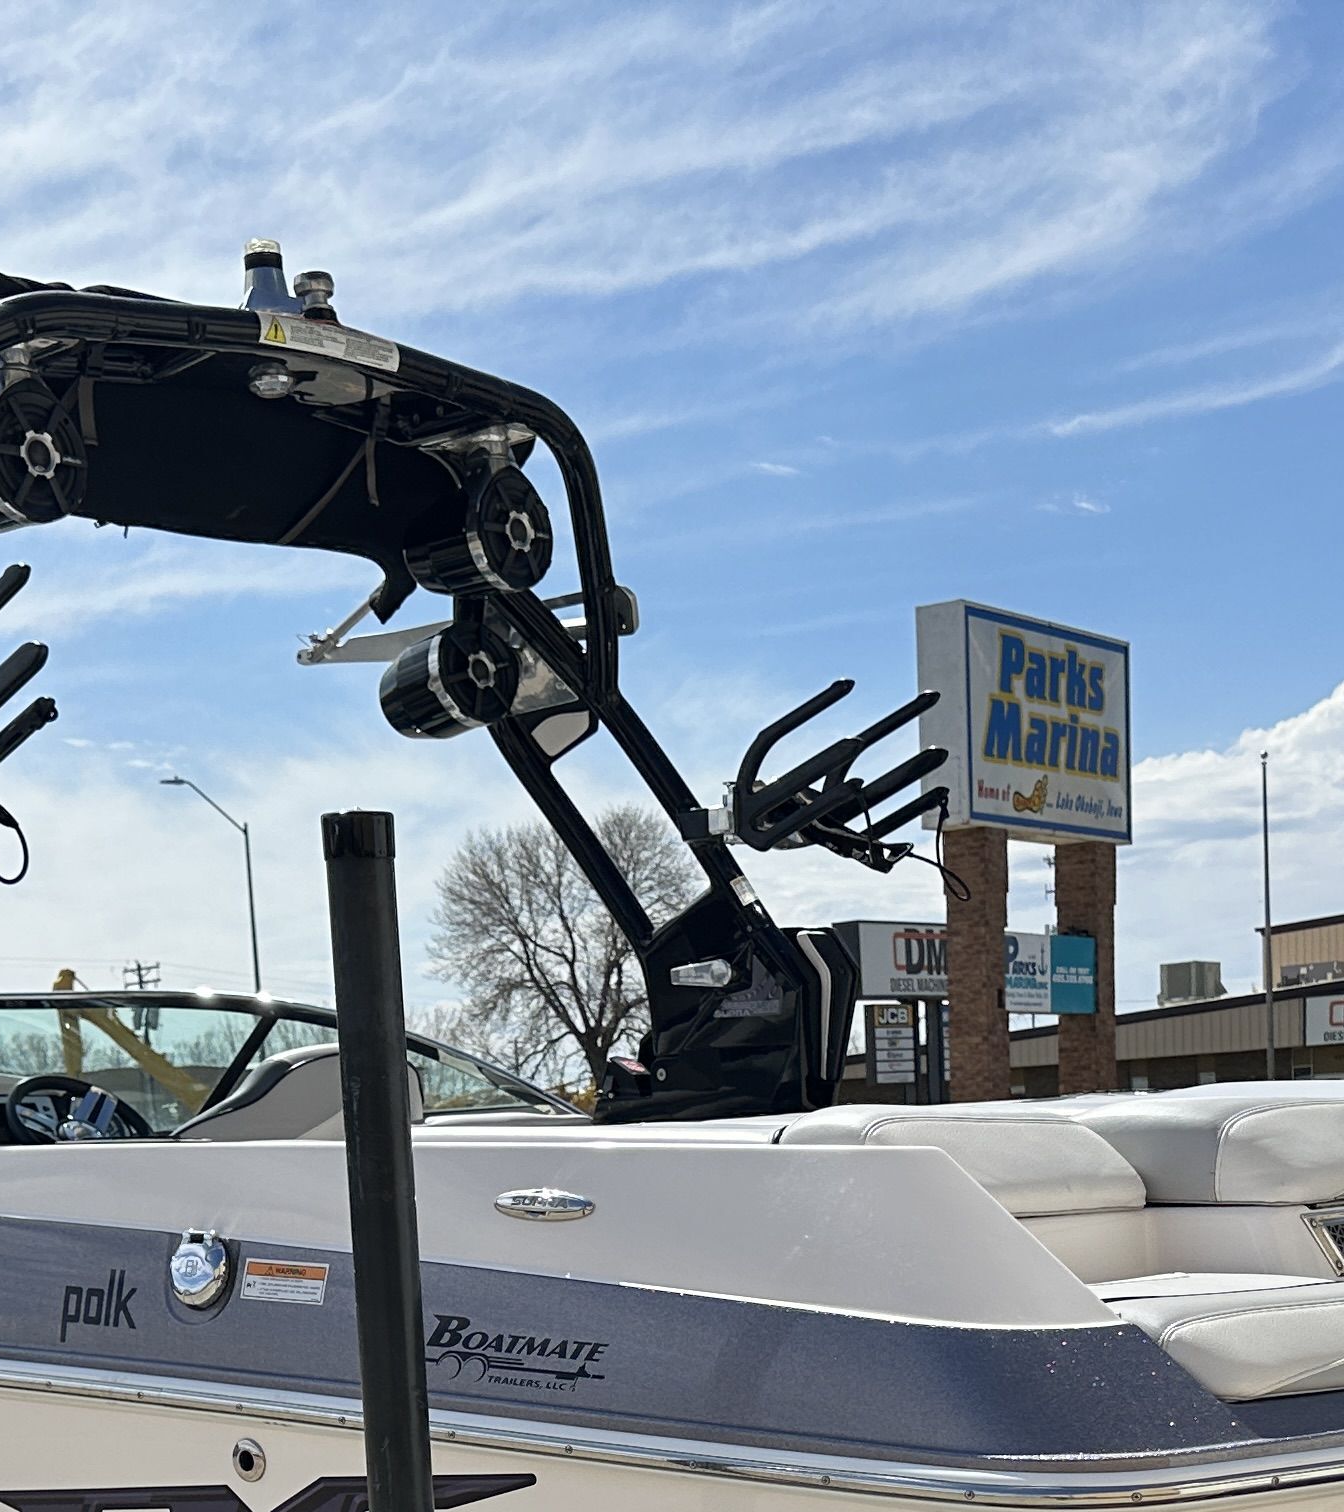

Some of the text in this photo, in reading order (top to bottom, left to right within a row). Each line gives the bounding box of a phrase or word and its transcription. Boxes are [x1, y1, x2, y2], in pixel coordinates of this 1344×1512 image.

[999, 631, 1105, 713] Parks
[983, 697, 1121, 780] Marina
[890, 978, 916, 993] DIESEL
[877, 1008, 909, 1024] JCB
[62, 1269, 137, 1342] polk
[426, 1314, 610, 1362] BOATMATE
[487, 1375, 567, 1391] TRAILERS, LLC
